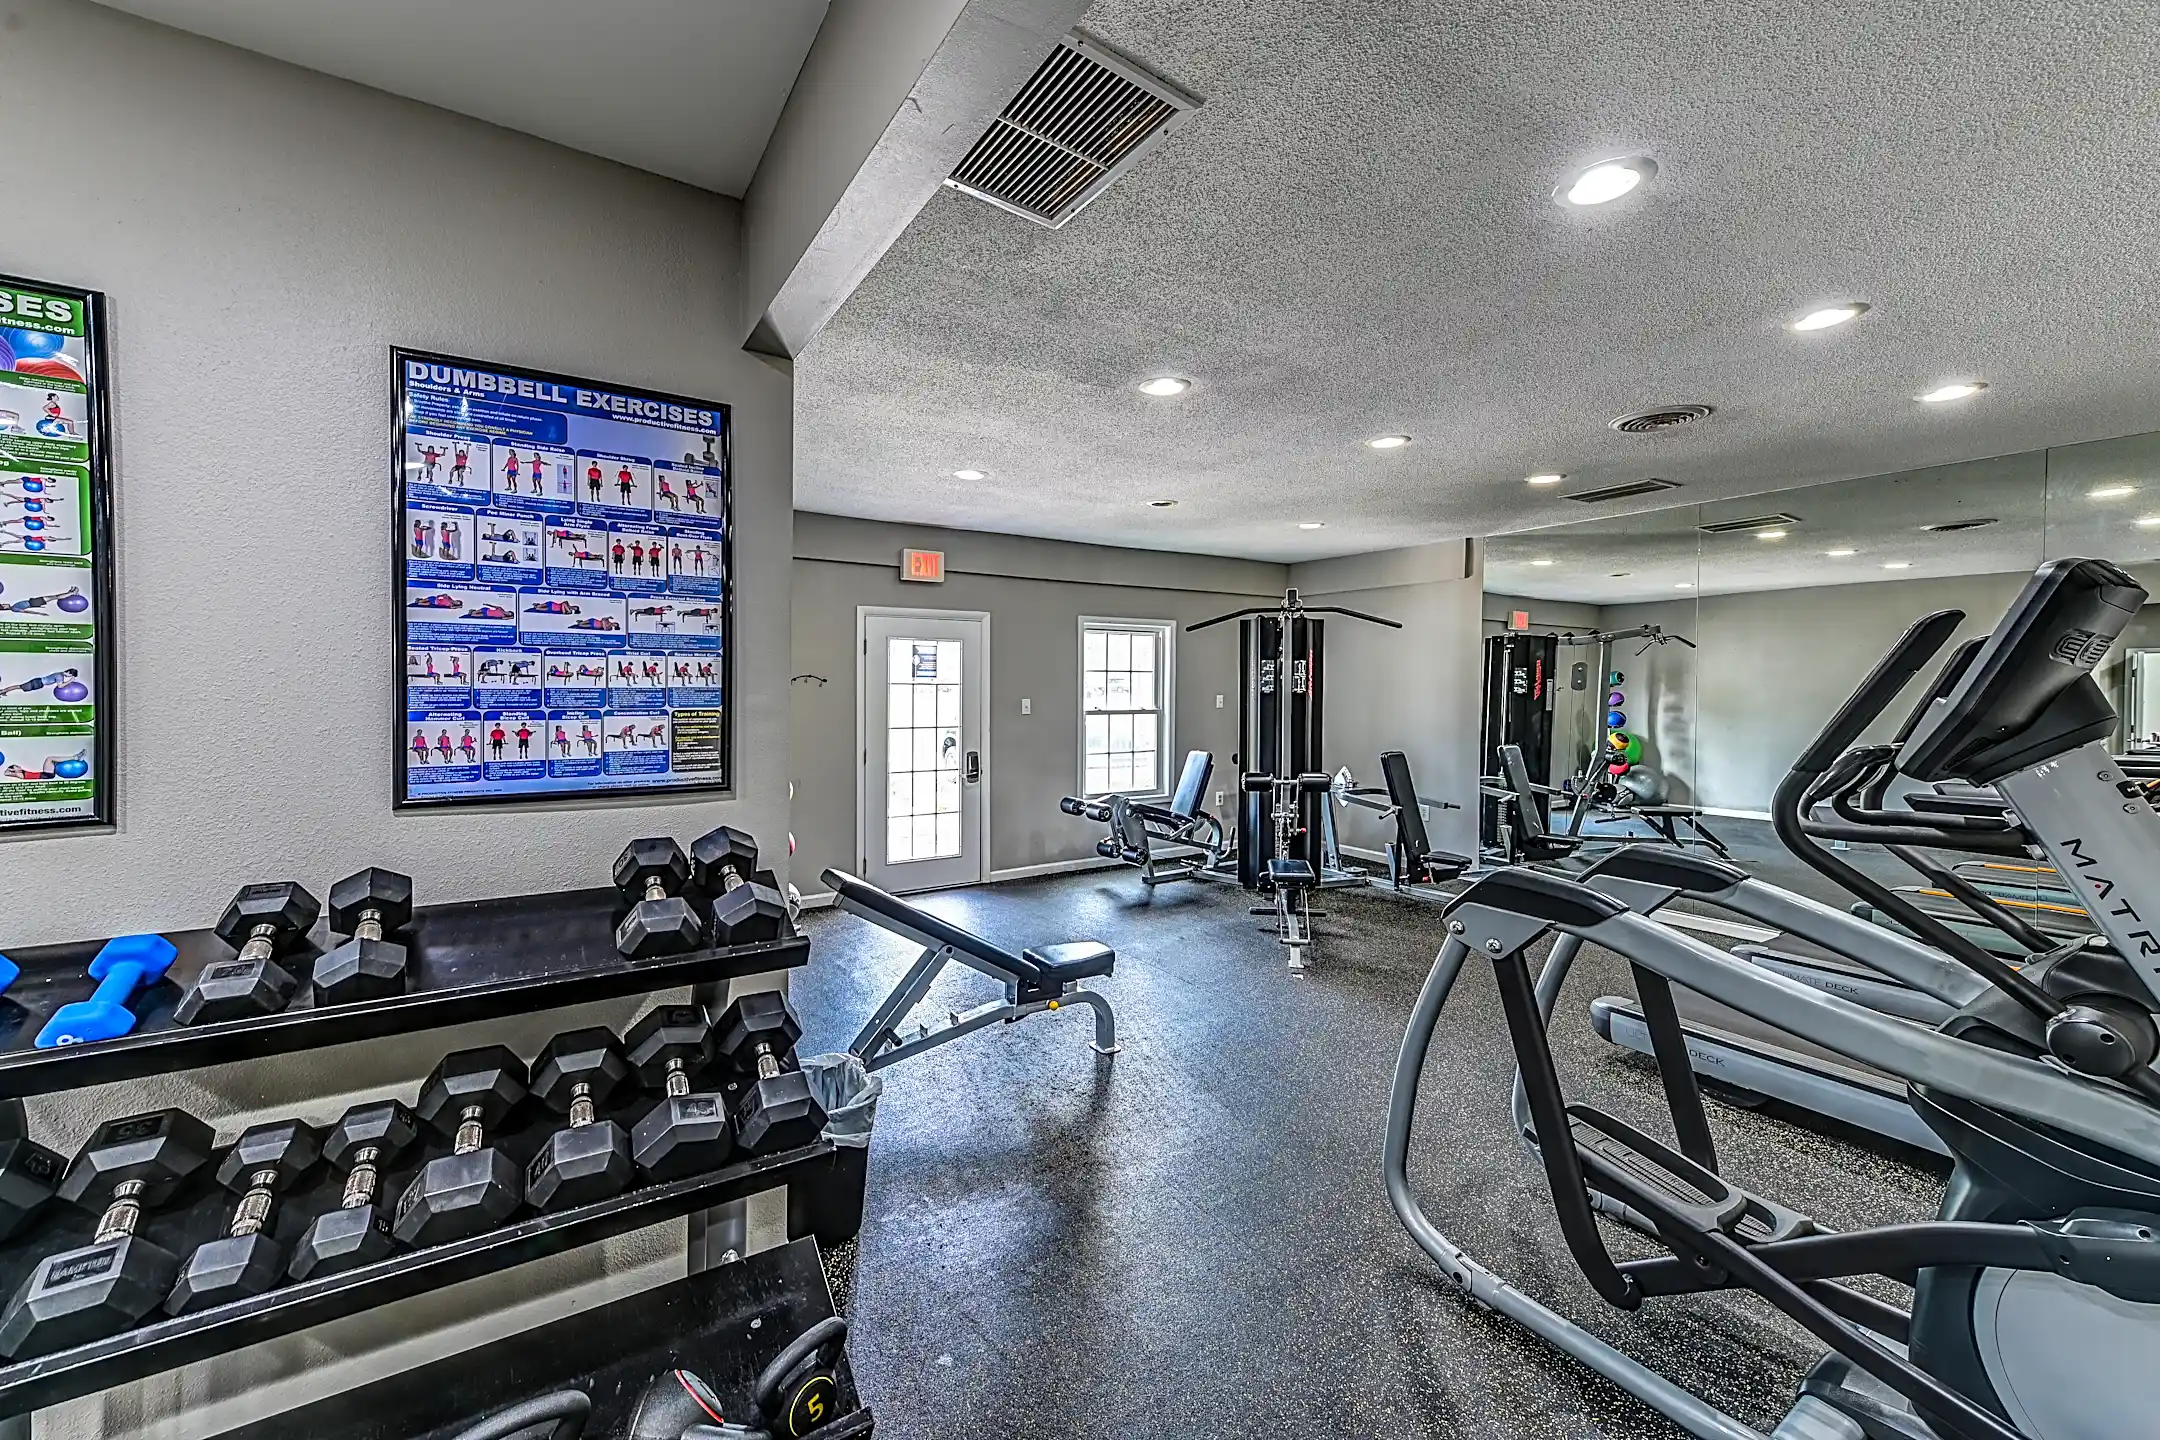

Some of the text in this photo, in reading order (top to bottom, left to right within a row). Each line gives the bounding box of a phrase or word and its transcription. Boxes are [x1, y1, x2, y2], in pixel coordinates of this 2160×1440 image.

[0, 316, 75, 334] tness.com
[408, 380, 451, 393] Shoulders
[463, 389, 485, 398] Arms
[409, 361, 713, 426] DUMBBELL EXERCISES
[430, 394, 449, 402] Rules
[612, 413, 717, 435] www.productivefitness.com
[426, 430, 471, 441] Shoulder Press
[510, 441, 535, 451] Standing
[596, 453, 636, 463] Shoulder Shrug
[421, 503, 458, 512] Screwdriver
[617, 522, 643, 531] Alternating
[911, 552, 940, 577] EXIT
[451, 583, 468, 591] Lying
[430, 645, 450, 653] Tricep
[2060, 838, 2160, 974] MATR
[1824, 981, 1859, 995] DECK
[1689, 1049, 1726, 1067] DECK
[807, 1392, 825, 1423] 5
